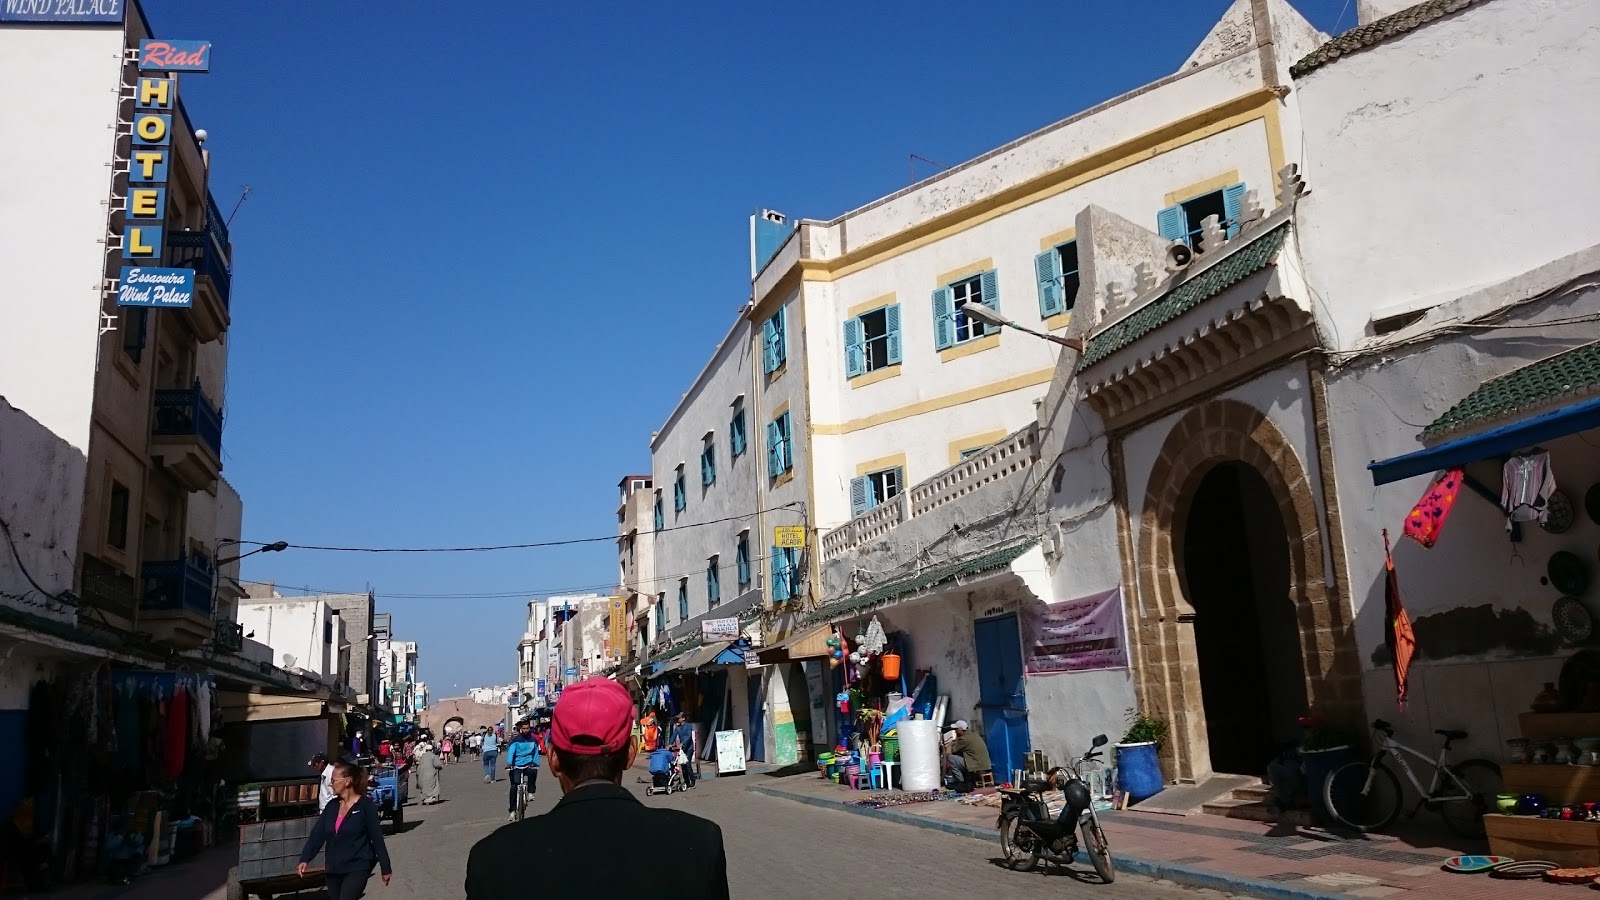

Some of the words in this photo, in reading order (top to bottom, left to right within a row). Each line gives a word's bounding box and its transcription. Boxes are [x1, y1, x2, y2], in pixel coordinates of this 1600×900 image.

[6, 0, 51, 14] WIND
[54, 0, 118, 15] PALACE
[142, 42, 206, 66] Riad
[130, 80, 168, 253] HOTEL
[127, 268, 185, 285] Essaouira
[120, 285, 152, 302] Wind
[152, 285, 190, 304] Palace
